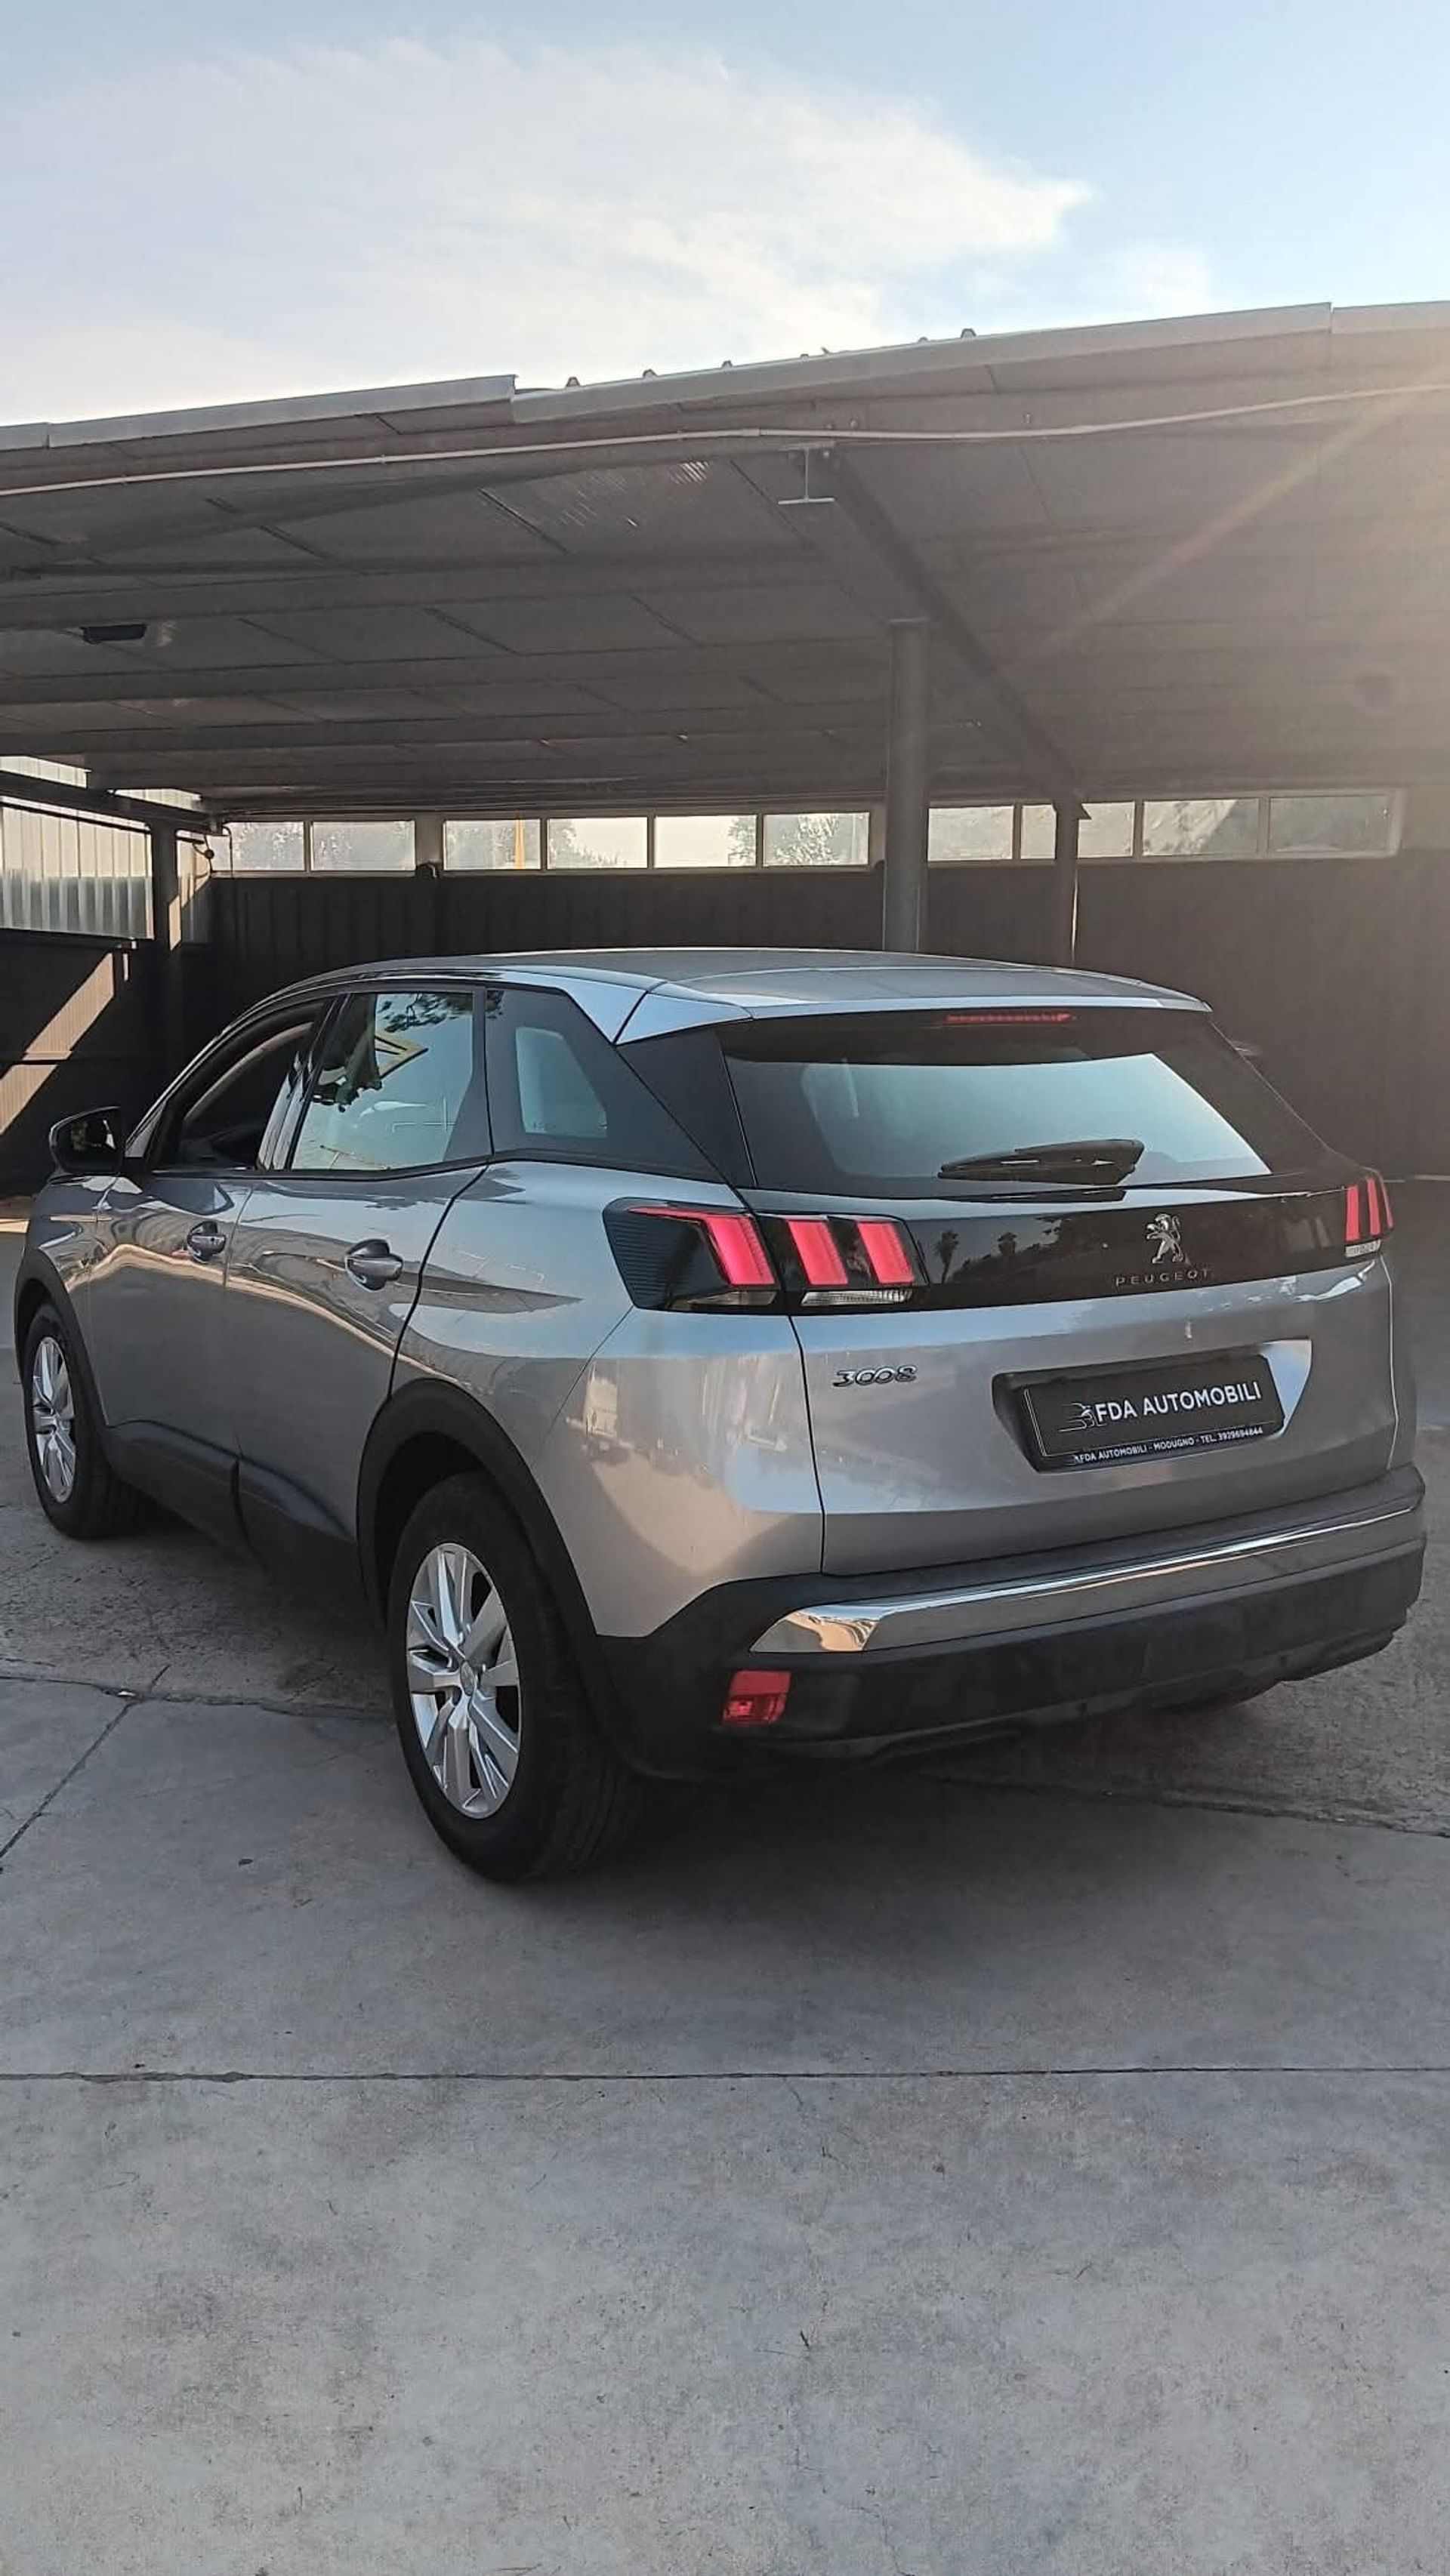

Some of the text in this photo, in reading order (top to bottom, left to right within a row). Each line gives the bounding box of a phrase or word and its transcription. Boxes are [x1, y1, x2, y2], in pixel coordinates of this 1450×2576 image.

[1115, 1268, 1211, 1286] PEUGEOT
[832, 1366, 918, 1388] 3008
[1096, 1381, 1263, 1423] FDA AUTOMOBILI
[1080, 1453, 1097, 1463] FDA
[1098, 1445, 1147, 1459] AUTOMOBILI
[1153, 1438, 1195, 1450] MODUGNO
[1201, 1434, 1217, 1444] TEL.
